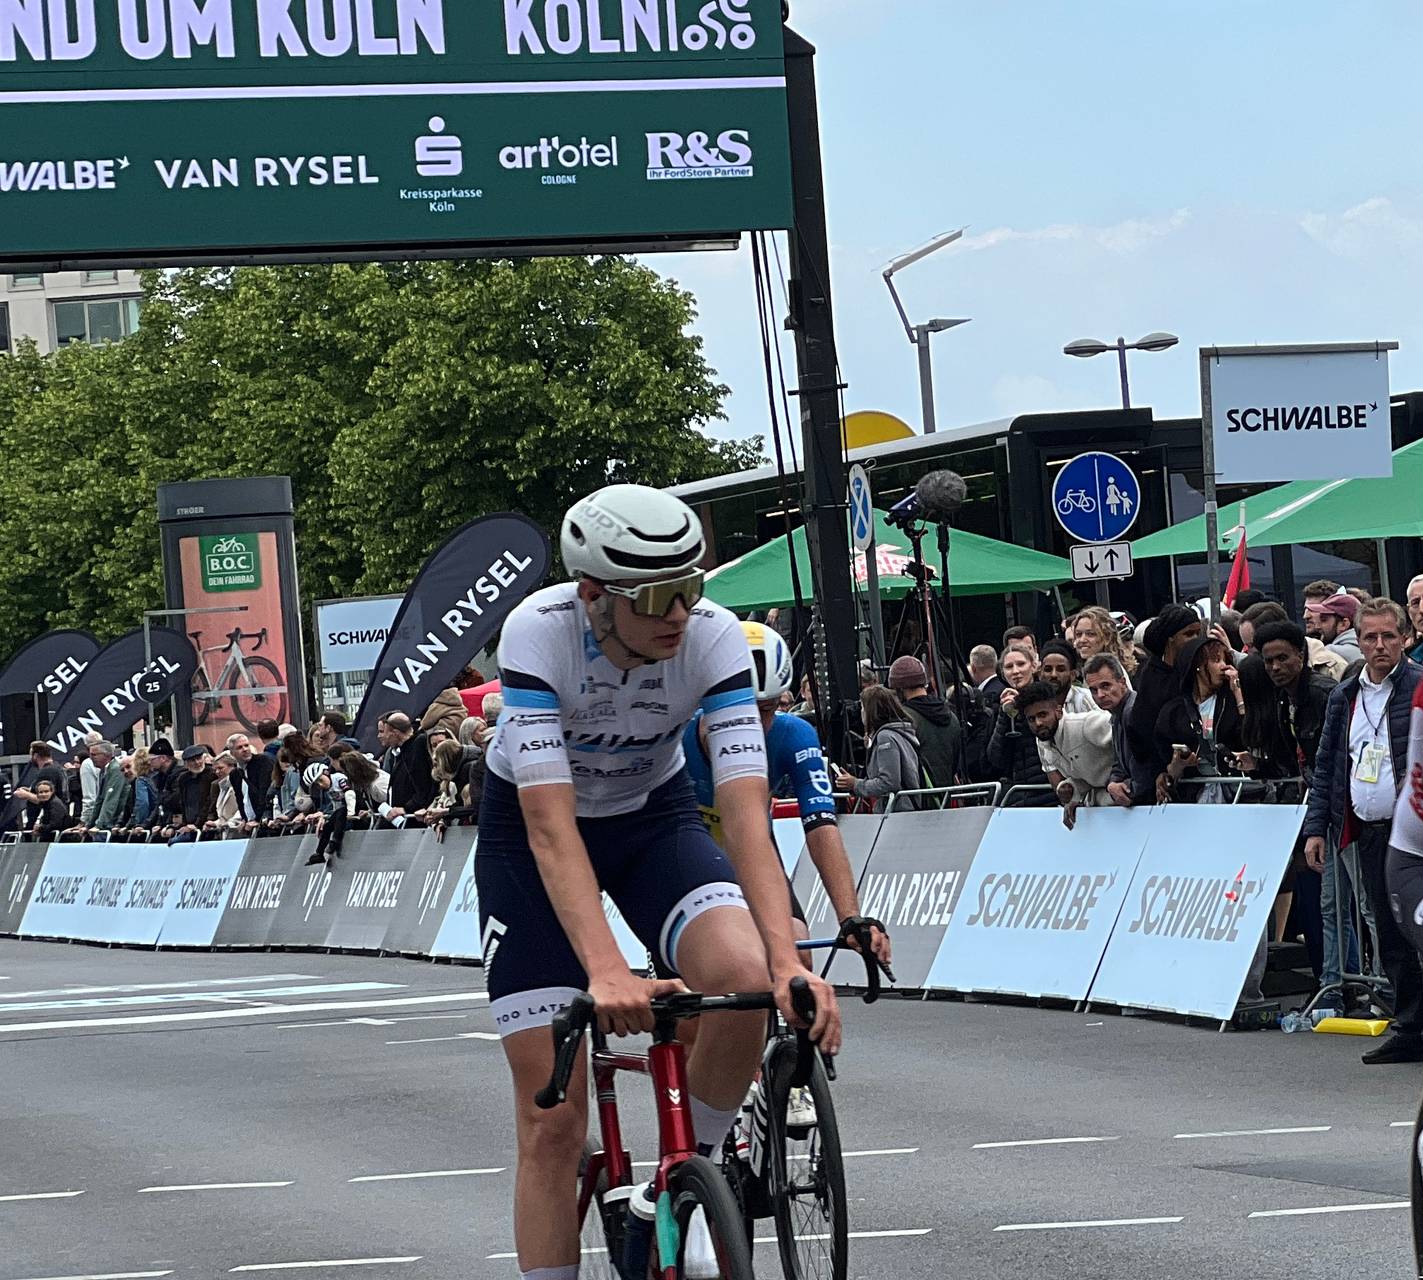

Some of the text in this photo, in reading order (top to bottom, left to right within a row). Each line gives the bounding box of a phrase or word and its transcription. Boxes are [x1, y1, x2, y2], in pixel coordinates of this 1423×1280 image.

[646, 129, 752, 168] R&S
[155, 155, 379, 189] VAN RYSEL
[541, 174, 577, 185] COLOGNE
[714, 167, 750, 178] Partner
[399, 187, 483, 201] Kreissparkasse
[429, 201, 456, 212] Köln
[1226, 404, 1368, 433] SCHWALBE
[208, 577, 224, 586] DEIN
[382, 550, 533, 694] VAN RYSEL
[36, 656, 89, 695] SEL
[145, 681, 161, 693] 25
[46, 708, 104, 754] VAN
[230, 876, 258, 909] VAN
[346, 872, 373, 908] VAN
[860, 870, 960, 926] VAN RYSEL
[966, 873, 1107, 931] SCHWALBE
[1128, 875, 1257, 942] SCHWALBE
